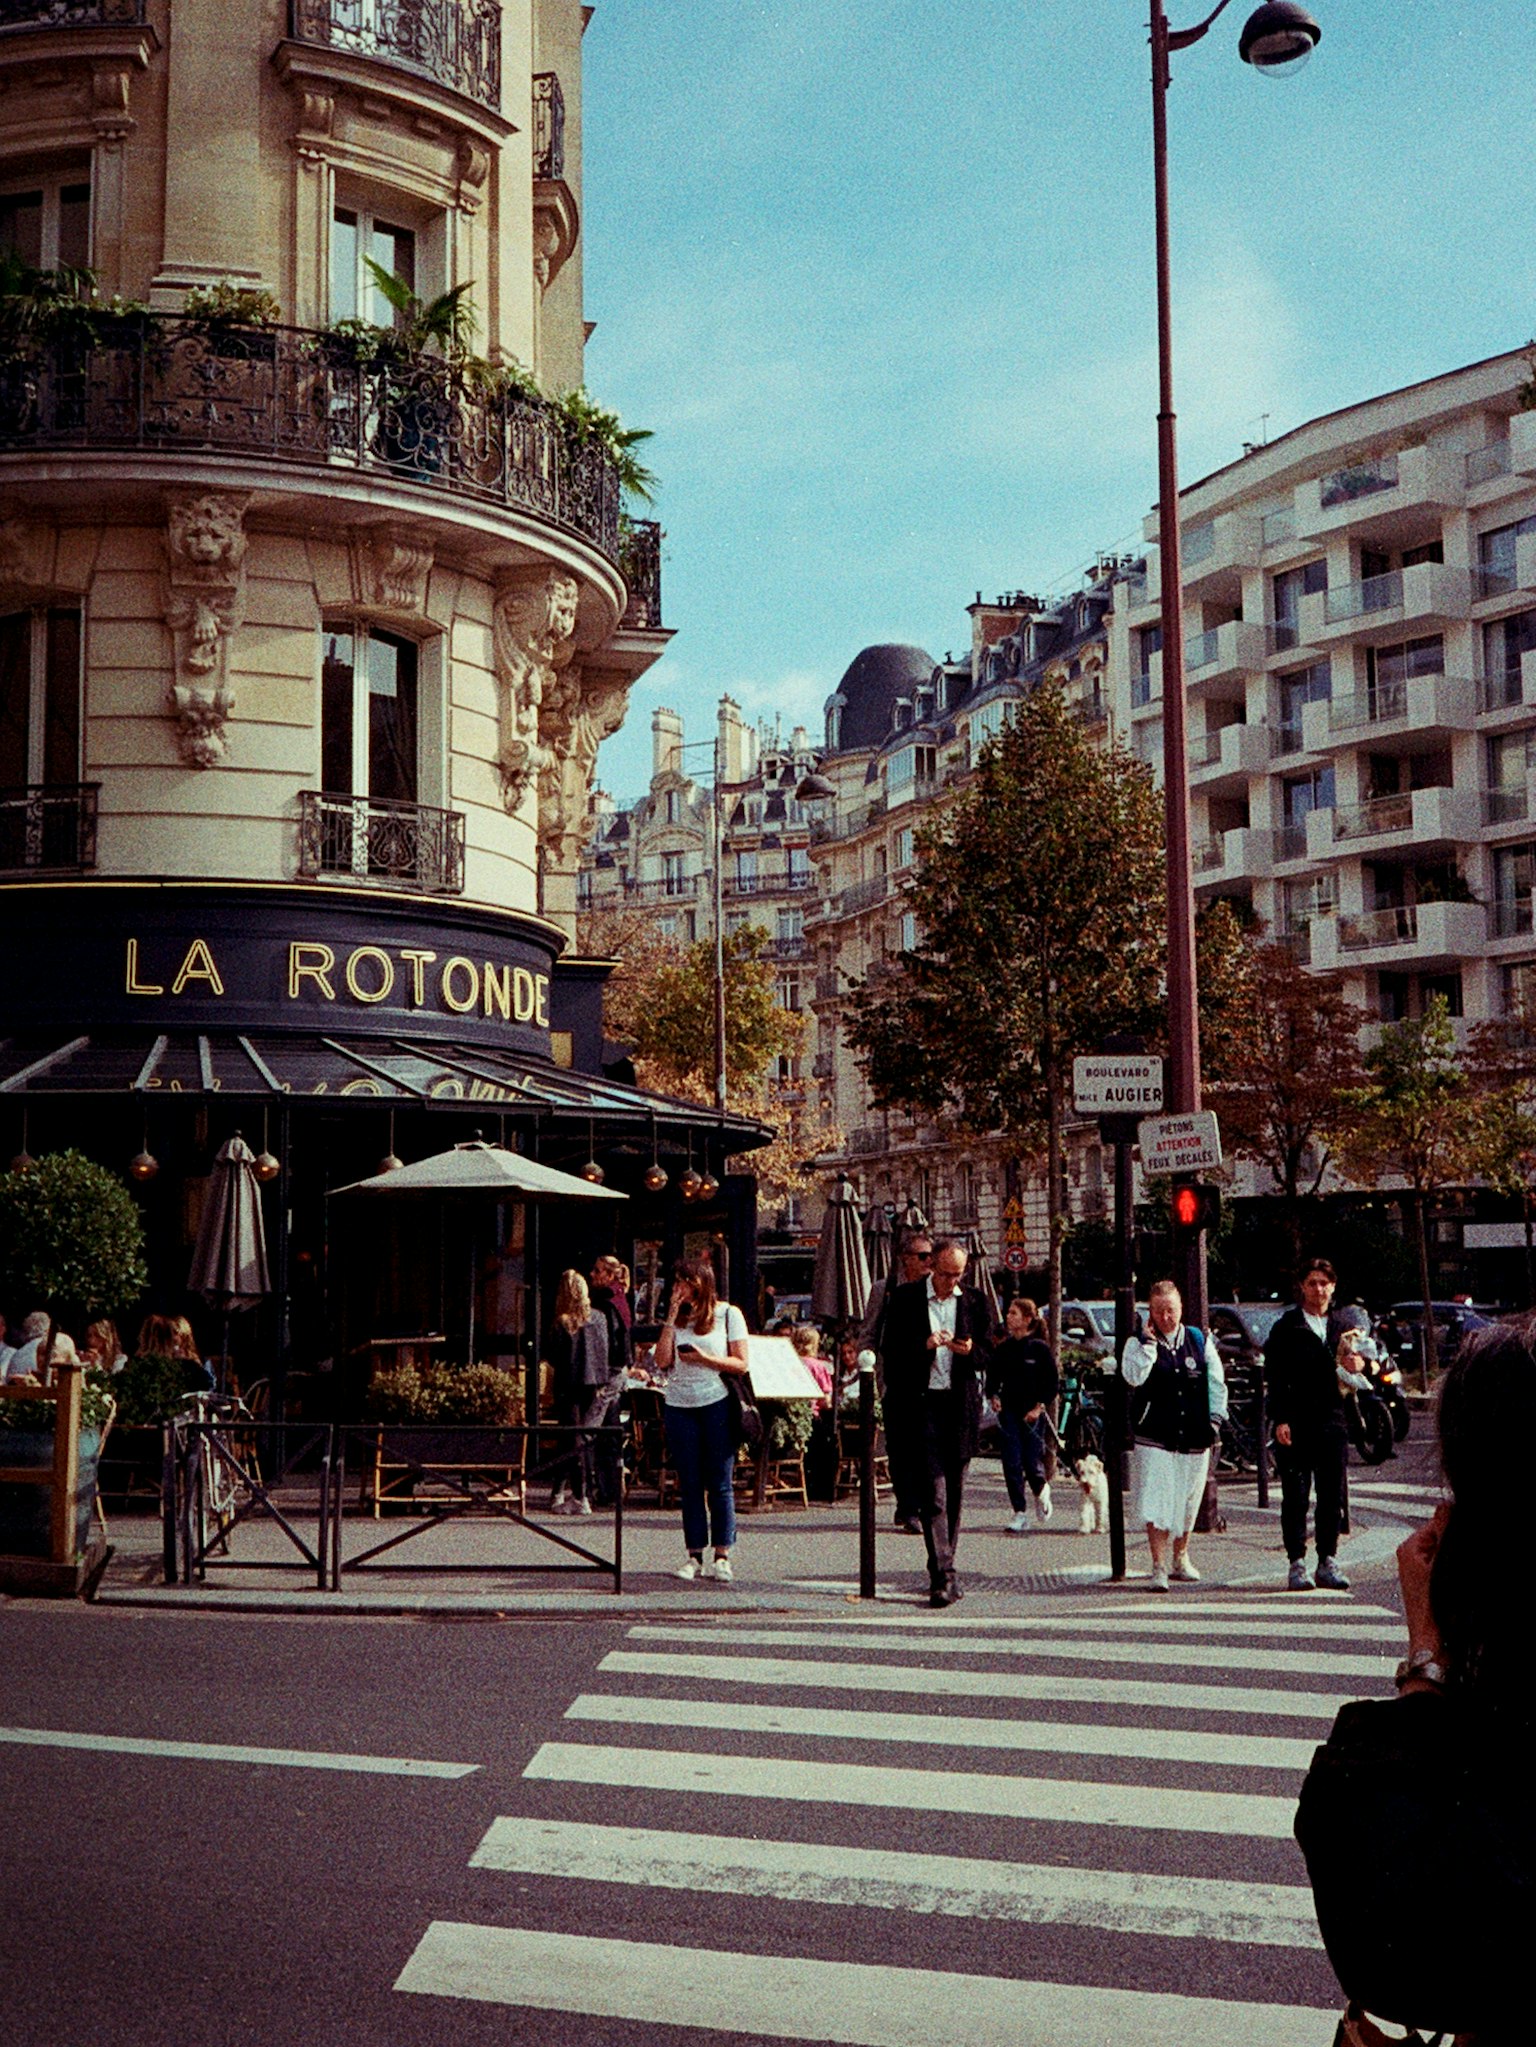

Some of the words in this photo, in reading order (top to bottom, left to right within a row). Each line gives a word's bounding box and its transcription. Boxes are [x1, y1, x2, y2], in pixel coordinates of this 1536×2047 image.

[126, 938, 225, 996] LA
[288, 941, 550, 1028] ROTONDE
[1085, 1066, 1150, 1078] BOULEVARD
[1105, 1087, 1162, 1102] AUGIER
[1159, 1120, 1195, 1135] PIÉTONS
[1155, 1136, 1202, 1153] ATTENTION
[1147, 1156, 1170, 1170] FEUX
[1010, 1252, 1024, 1265] 30
